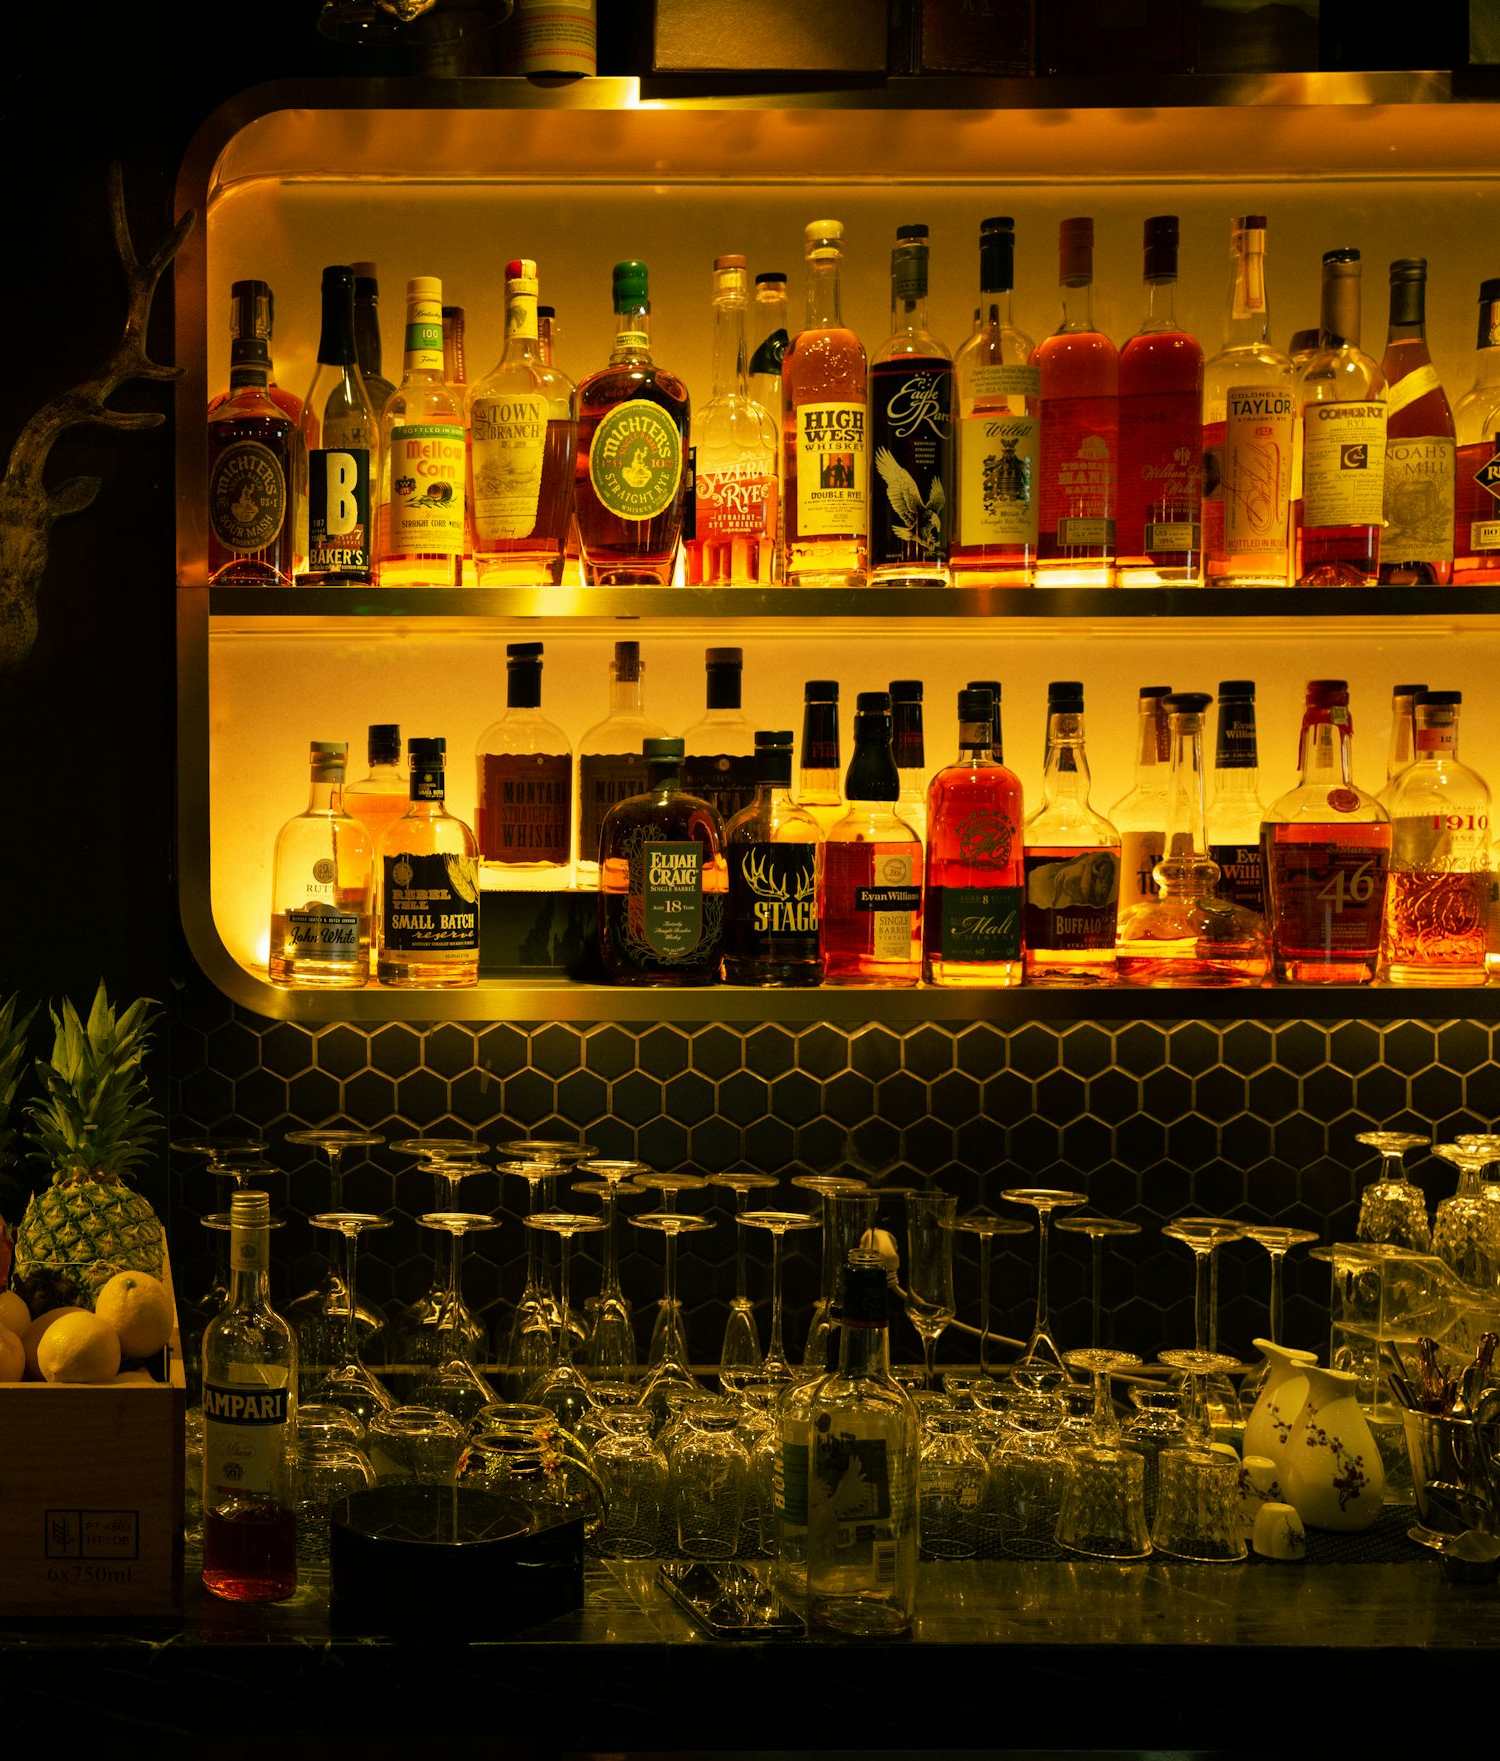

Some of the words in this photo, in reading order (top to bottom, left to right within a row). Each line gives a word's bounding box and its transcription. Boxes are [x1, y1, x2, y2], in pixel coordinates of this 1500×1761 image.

[421, 328, 439, 341] 100
[1231, 391, 1278, 400] COLONEL
[491, 402, 541, 423] TOWN
[1231, 399, 1291, 416] TAYLOR
[804, 409, 864, 431] HIGH
[403, 427, 441, 435] BOTTLED
[490, 423, 540, 441] BRANCH
[602, 415, 672, 459] MICHTER'S
[804, 429, 864, 443] WEST
[406, 440, 463, 460] Mellow
[804, 443, 864, 452] WHISKEY
[1385, 445, 1446, 460] NOAH'S
[416, 460, 457, 478] Corn
[651, 459, 666, 469] 10
[1405, 461, 1448, 475] MILL
[326, 451, 358, 536] B
[604, 472, 653, 506] STRAIGHT
[654, 471, 671, 494] RYE
[811, 491, 844, 500] DOUBLE
[401, 520, 429, 529] STRAIGHT
[717, 513, 756, 521] STRAIGHT
[728, 520, 764, 529] WHISKEY
[219, 514, 245, 538] SOUR
[246, 514, 274, 538] MASH
[353, 529, 363, 541] 7
[1228, 539, 1261, 549] BOTTLED
[309, 548, 364, 565] BAKER'S
[1432, 814, 1489, 832] 1910
[649, 851, 698, 870] ELIJAH
[648, 869, 697, 886] CRAIG
[1316, 859, 1375, 914] 46
[860, 891, 887, 902] Evan
[887, 890, 920, 901] Williams
[664, 900, 682, 913] 18
[392, 913, 435, 930] SMALL
[440, 912, 474, 929] BATCH
[879, 916, 909, 926] SINGLE
[950, 909, 1017, 936] Malt
[1055, 915, 1101, 936] BUFFALO
[288, 925, 319, 947] John
[319, 925, 357, 944] White
[411, 929, 474, 940] reserve
[878, 926, 909, 934] BARREL
[205, 1389, 282, 1420] AMPARI
